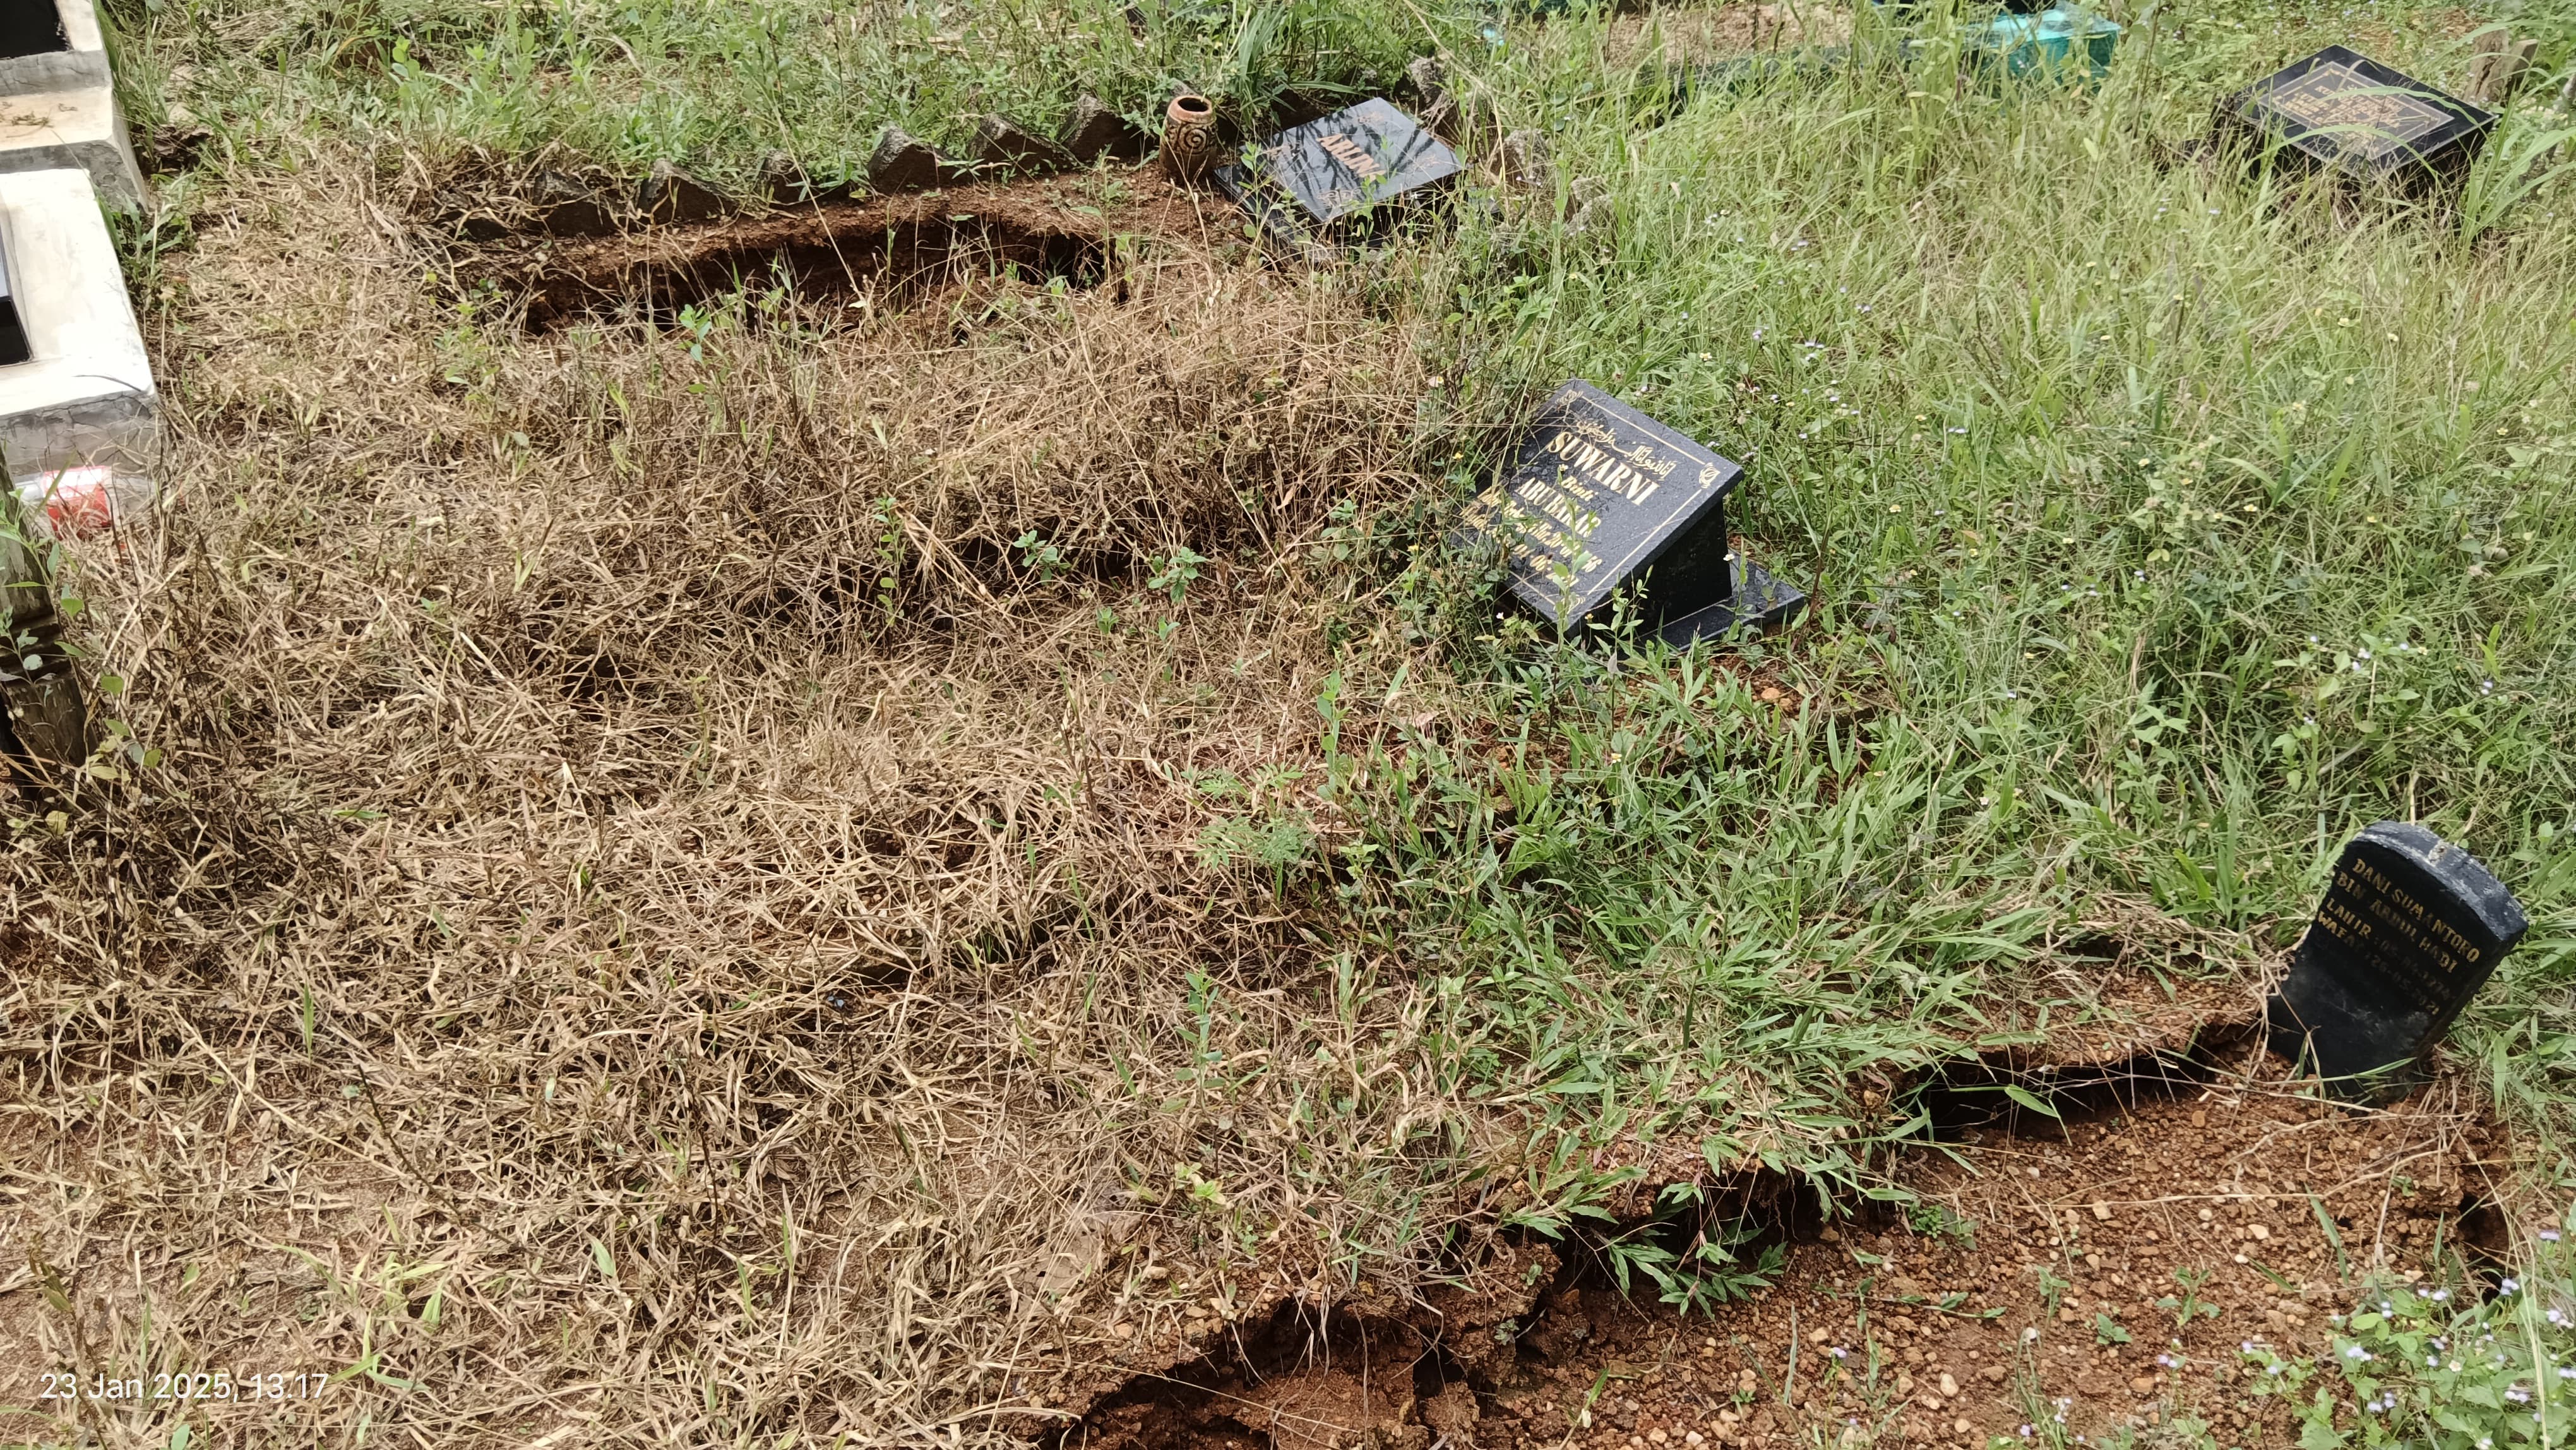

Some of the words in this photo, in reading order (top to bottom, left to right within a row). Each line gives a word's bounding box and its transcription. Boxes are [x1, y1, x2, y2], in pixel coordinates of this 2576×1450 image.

[1514, 476, 1556, 508] ABU
[1544, 430, 1660, 506] SUWARNI
[1559, 475, 1599, 503] Binti
[2324, 896, 2375, 940] LAHIR
[2334, 870, 2367, 901] BIN
[2416, 935, 2460, 974] HADI
[2351, 856, 2393, 896] DANI
[2388, 886, 2484, 964] SUMANTORO
